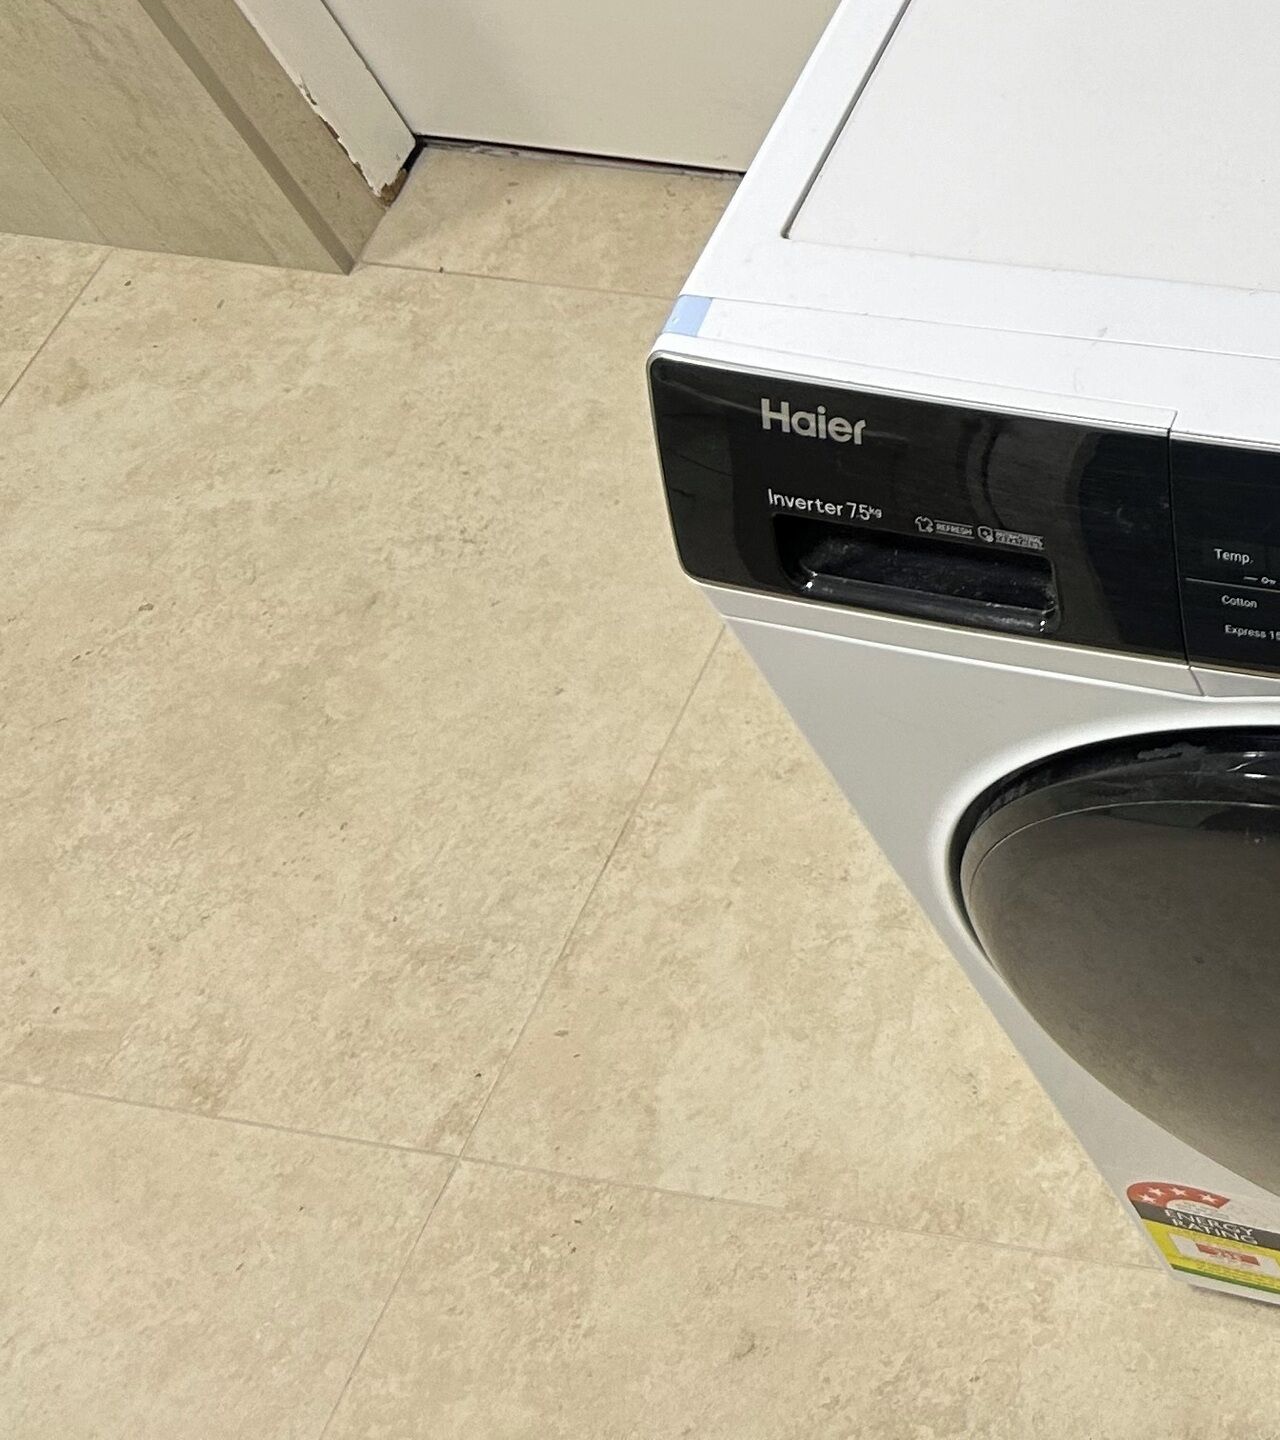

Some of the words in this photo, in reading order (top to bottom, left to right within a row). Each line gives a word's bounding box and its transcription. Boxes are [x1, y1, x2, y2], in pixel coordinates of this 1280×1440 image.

[761, 398, 866, 445] Haier
[768, 488, 843, 516] Inverter
[1221, 595, 1258, 609] Cotton
[1225, 624, 1267, 640] Express
[1165, 1210, 1252, 1236] ENERGY
[1173, 1219, 1258, 1245] RATING
